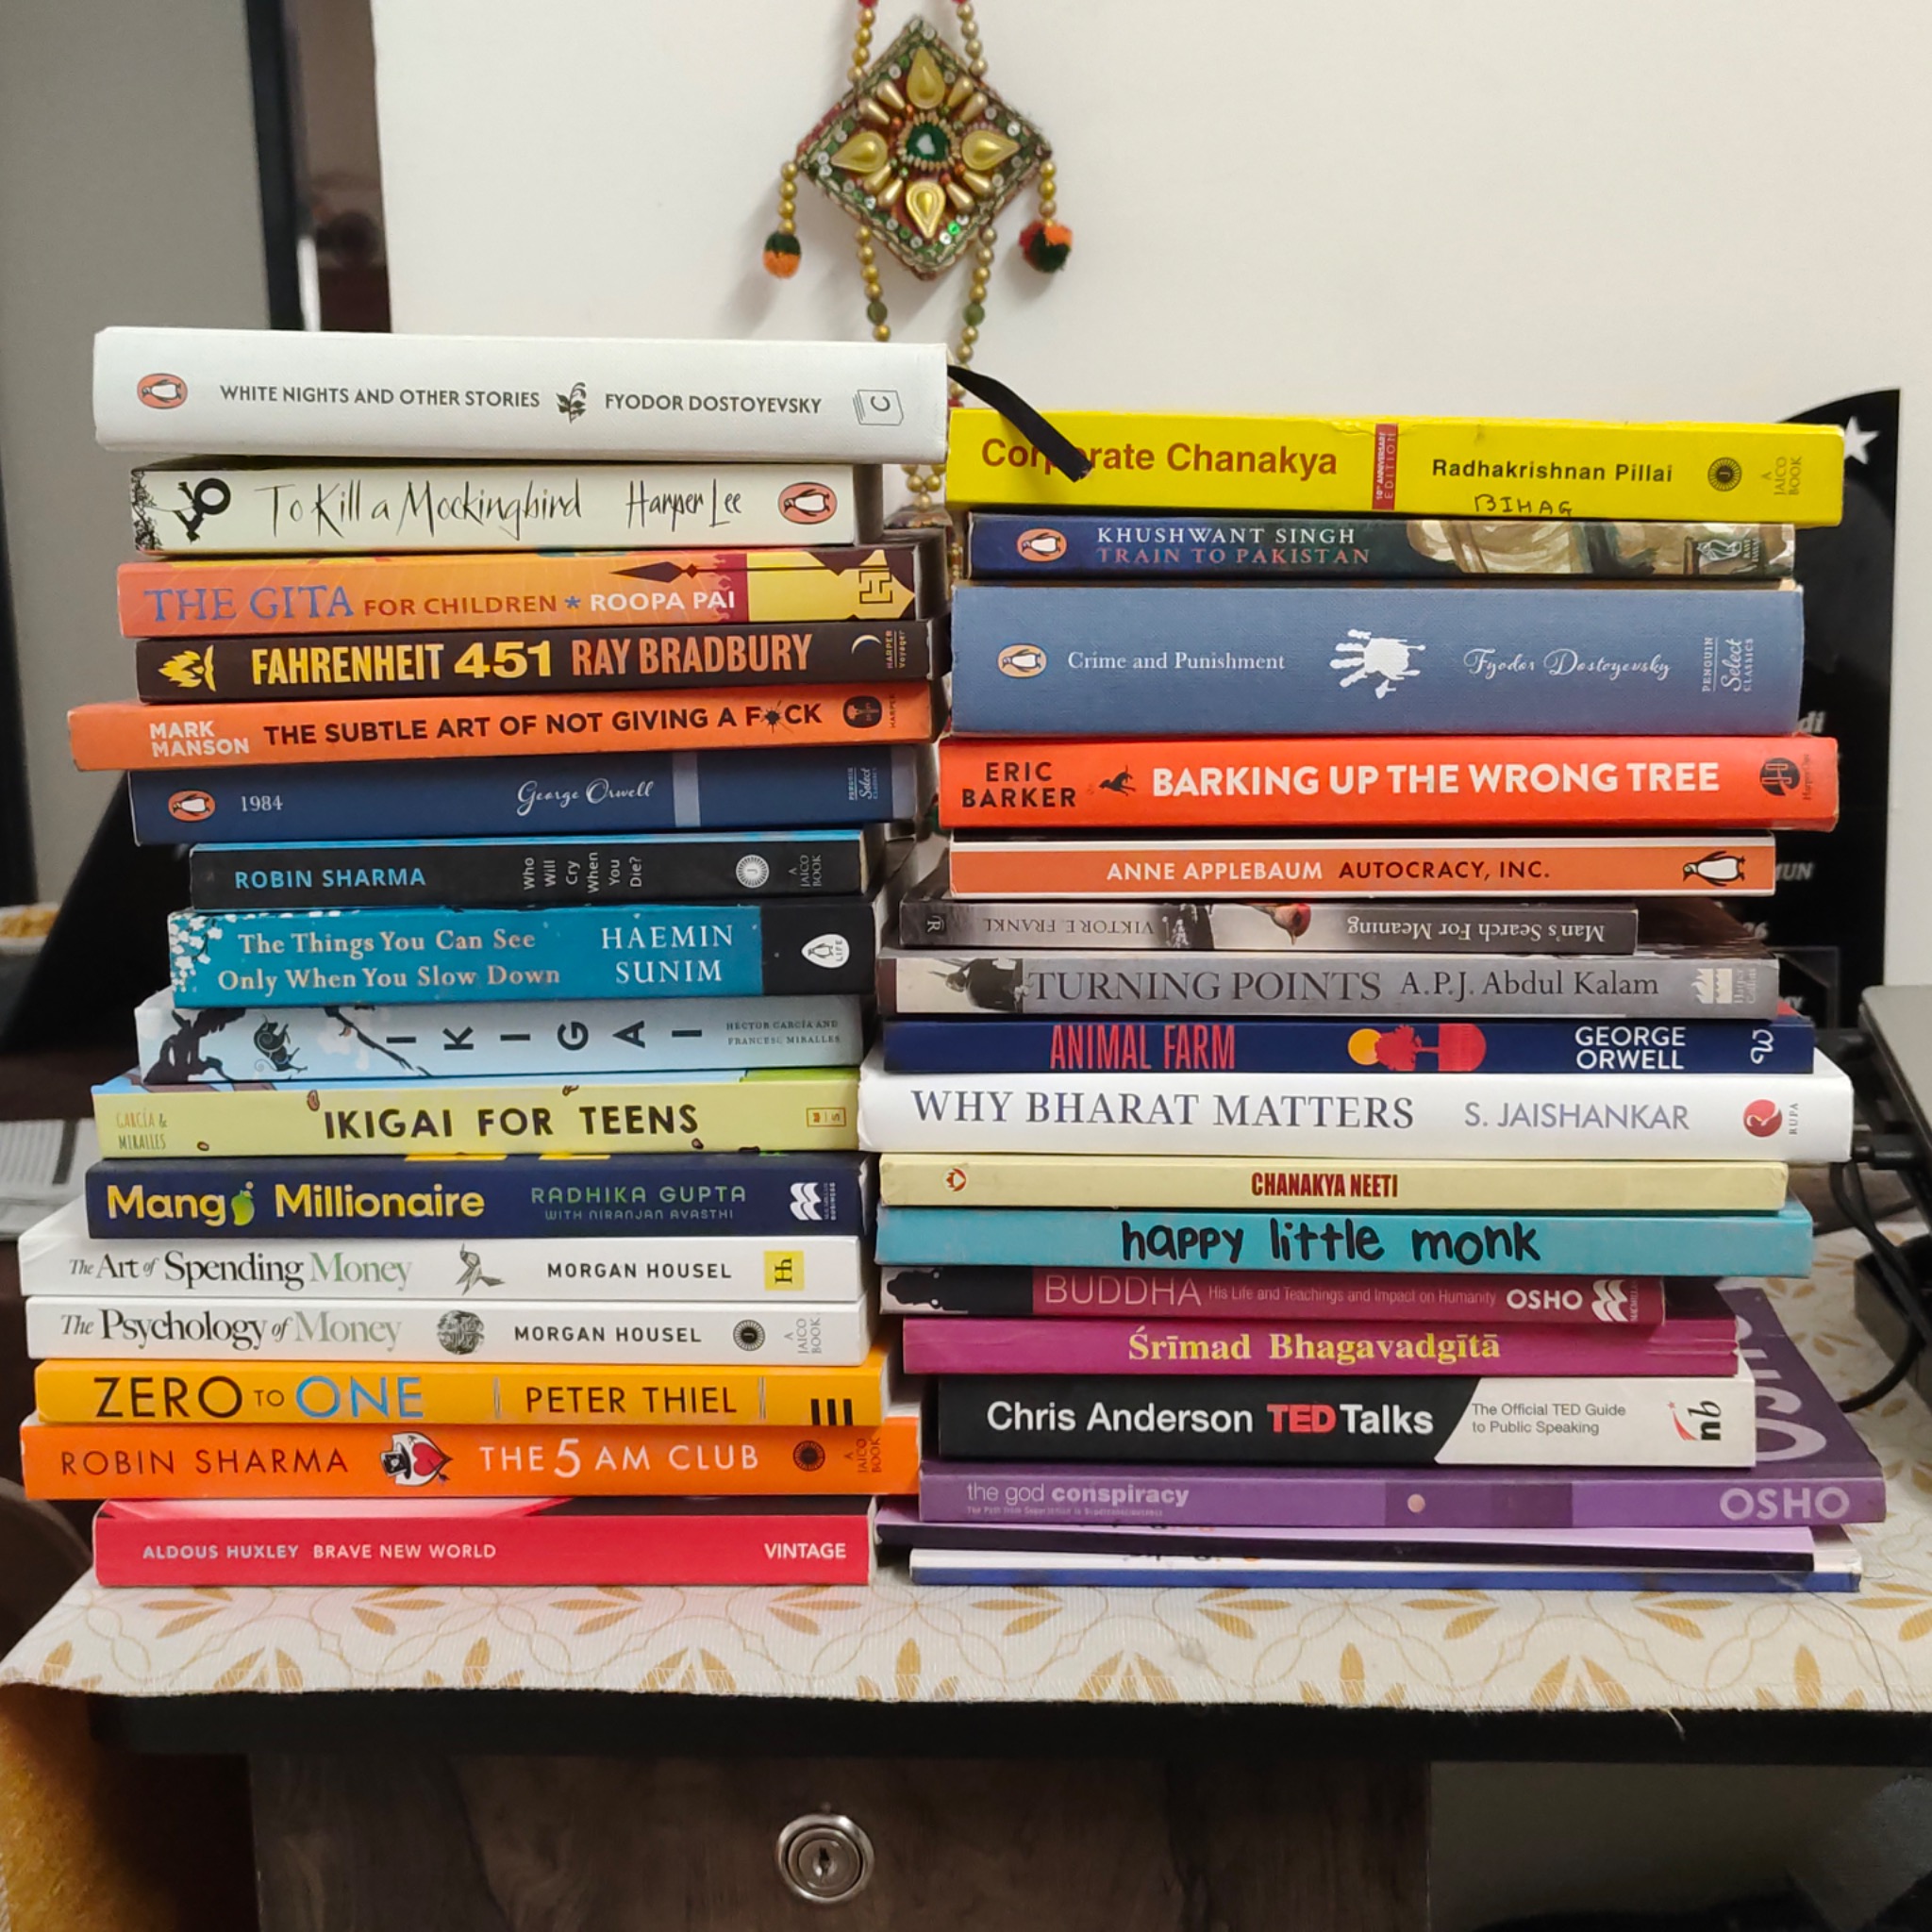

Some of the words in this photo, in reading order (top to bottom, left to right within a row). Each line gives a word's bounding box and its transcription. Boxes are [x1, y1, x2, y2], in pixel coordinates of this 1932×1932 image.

[220, 385, 277, 401] WHITE
[283, 387, 349, 404] NIGHTS
[355, 389, 393, 404] AND
[400, 390, 459, 406] OTHER
[465, 391, 541, 408] STORIES
[606, 394, 683, 410] FYODOR
[690, 396, 822, 414] DOSTOYEVSKY
[982, 438, 1155, 474] Corrate
[1167, 443, 1337, 480] Chanakya
[1385, 434, 1395, 498] EDITION
[1432, 459, 1605, 480] Radhakrishnan
[1615, 463, 1673, 482] Pillai
[1761, 472, 1772, 480] A
[1774, 457, 1787, 494] JAICO
[1789, 457, 1802, 495] BOOK
[625, 480, 705, 532] Harper
[709, 479, 742, 527] Lee
[1474, 493, 1573, 516] BIHAG
[1098, 527, 1264, 543] KHUSHWANT
[1274, 529, 1355, 543] SINGH
[1096, 548, 1179, 562] TRAIN
[1191, 549, 1225, 562] TO
[1236, 549, 1371, 563] PAKISTAN
[144, 589, 237, 621] THE
[250, 586, 353, 618] GITA
[364, 599, 415, 616] FOR
[425, 594, 557, 616] CHILDREN
[591, 592, 685, 611] ROOPA
[694, 591, 735, 608] PAI
[252, 644, 443, 684] FAHRENHEIT
[454, 641, 552, 679] 451
[885, 630, 893, 669] HARPER
[1068, 652, 1126, 670] Crime
[1133, 653, 1167, 669] and
[1175, 652, 1285, 671] Punishment
[1702, 637, 1713, 691] PENGUIN
[1464, 649, 1535, 679] Fyodor
[1543, 649, 1671, 680] Dostoyevsky
[1721, 638, 1742, 691] Select
[149, 721, 214, 738] MARK
[153, 738, 249, 757] MANSON
[986, 761, 1052, 782] ERIC
[241, 795, 283, 812] 1984
[517, 781, 580, 815] George
[586, 778, 654, 805] Orwell
[962, 789, 1076, 808] BARKER
[236, 871, 312, 889] ROBIN
[323, 868, 426, 888] SHARMA
[524, 858, 535, 890] Who
[544, 860, 557, 887] Will
[567, 860, 580, 884] Cry
[587, 852, 599, 893] When
[608, 859, 620, 886] You
[630, 857, 642, 888] Die?
[1339, 861, 1490, 881] AUTOCRACY,
[1500, 862, 1550, 878] INC.
[983, 918, 1056, 932] FRANKL
[1082, 921, 1154, 934] VIKTOR
[1348, 917, 1431, 940] Meaning
[1440, 923, 1471, 941] For
[1478, 924, 1541, 941] Search
[1549, 924, 1605, 941] Man's
[238, 934, 285, 953] The
[291, 933, 375, 960] Things
[380, 931, 425, 951] You
[436, 930, 482, 950] Can
[493, 930, 535, 947] See
[835, 940, 843, 961] LIFE
[218, 971, 277, 996] Only
[285, 970, 356, 989] When
[362, 968, 407, 987] You
[417, 967, 475, 986] Slow
[488, 966, 559, 984] Down
[1399, 972, 1474, 1003] A.P.J.
[1482, 970, 1563, 995] Abdul
[1574, 970, 1658, 995] Kalam
[815, 1020, 838, 1028] AND
[1050, 1024, 1151, 1070] ANIMAL
[1164, 1024, 1236, 1070] FARM
[325, 1108, 453, 1139] IKIGAI
[478, 1107, 553, 1137] FOR
[579, 1104, 698, 1135] TEENS
[911, 1090, 1012, 1122] WHY
[1025, 1091, 1199, 1124] BHARAT
[1213, 1094, 1413, 1129] MATTERS
[1789, 1103, 1798, 1135] RUPA
[275, 1184, 485, 1218] Millionaire
[531, 1188, 646, 1204] RADHIKA
[659, 1186, 746, 1203] GUPTA
[545, 1209, 583, 1221] WITH
[670, 1209, 733, 1220] AVASTHI
[70, 1259, 93, 1275] The
[96, 1253, 139, 1278] Art
[142, 1259, 159, 1277] of
[165, 1250, 304, 1291] Spending
[310, 1252, 412, 1291] Money
[548, 1263, 637, 1278] MORGAN
[647, 1263, 731, 1278] HOUSEL
[1209, 1286, 1226, 1299] His
[1232, 1286, 1252, 1300] Life
[1257, 1287, 1279, 1301] and
[1285, 1287, 1343, 1305] Teachings
[1348, 1288, 1370, 1302] and
[1374, 1289, 1414, 1304] Impact
[1420, 1291, 1434, 1303] on
[1439, 1291, 1496, 1306] Humanity
[1507, 1289, 1583, 1310] OSHO
[61, 1314, 93, 1335] The
[99, 1308, 266, 1351] Psychology
[272, 1321, 292, 1342] of
[293, 1310, 401, 1352] Money
[796, 1318, 808, 1354] JAICO
[811, 1318, 822, 1354] BOOK
[987, 1401, 1075, 1431] Chris
[1087, 1403, 1253, 1433] Anderson
[1267, 1404, 1336, 1433] TED
[1340, 1404, 1433, 1435] Talks
[1472, 1404, 1498, 1416] The
[1502, 1403, 1548, 1416] Official
[1552, 1404, 1581, 1416] TED
[1585, 1404, 1626, 1417] Guide
[1472, 1423, 1486, 1433] to
[1490, 1421, 1531, 1434] Public
[1536, 1421, 1600, 1436] Speaking
[480, 1447, 544, 1471] THE
[554, 1439, 581, 1478] 5
[595, 1447, 648, 1470] AM
[668, 1445, 758, 1469] CLUB
[967, 1483, 998, 1501] the
[1005, 1484, 1044, 1506] god
[1052, 1484, 1189, 1507] conspiracy
[1720, 1487, 1850, 1521] OSHO
[143, 1545, 218, 1559] ALDOUS
[227, 1545, 299, 1558] HUXLEY
[313, 1544, 371, 1558] BRAVE
[380, 1544, 421, 1558] NEW
[429, 1544, 496, 1558] WORLD
[764, 1543, 846, 1558] VINTAGE
